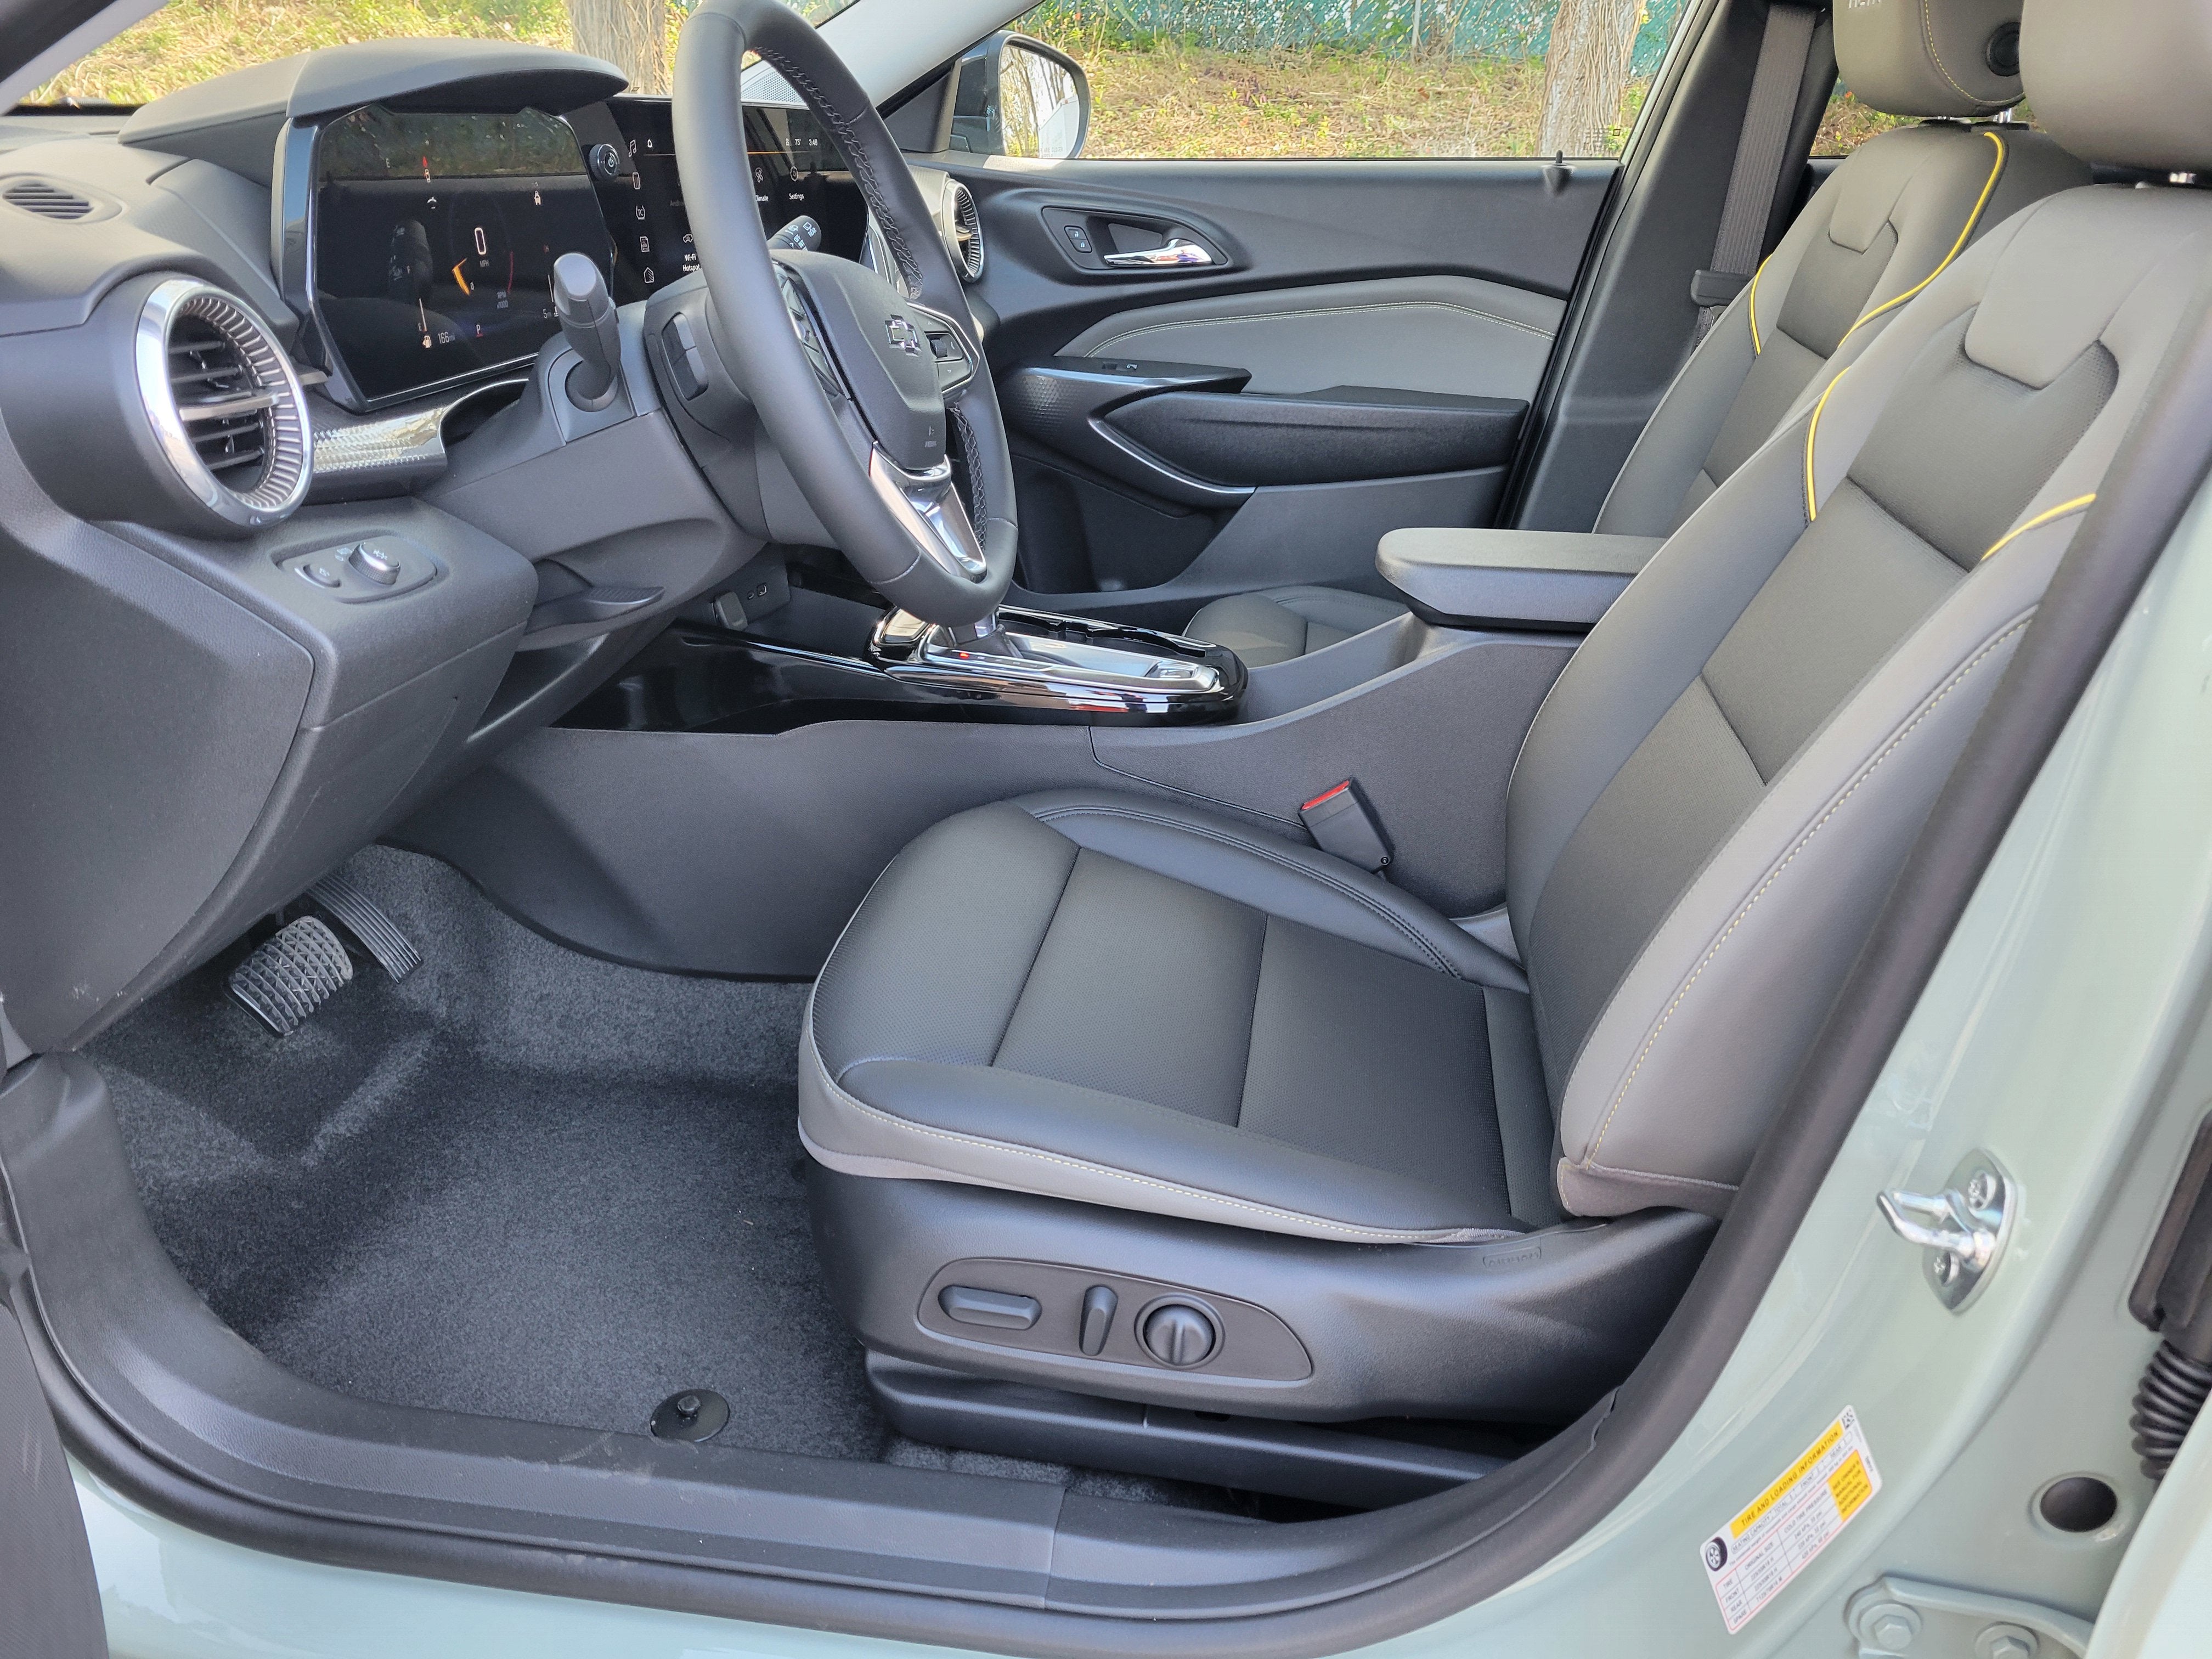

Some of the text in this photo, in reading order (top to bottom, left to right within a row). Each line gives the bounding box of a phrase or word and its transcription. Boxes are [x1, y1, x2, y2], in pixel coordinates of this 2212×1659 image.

[474, 227, 486, 255] 0
[479, 259, 489, 268] MPH
[682, 264, 700, 272] Hotspot
[476, 324, 481, 334] P
[1741, 1509, 1756, 1527] TIRE
[1756, 1497, 1769, 1514] AND
[1770, 1471, 1797, 1500] LOADING
[1798, 1430, 1839, 1473] INFORMATION
